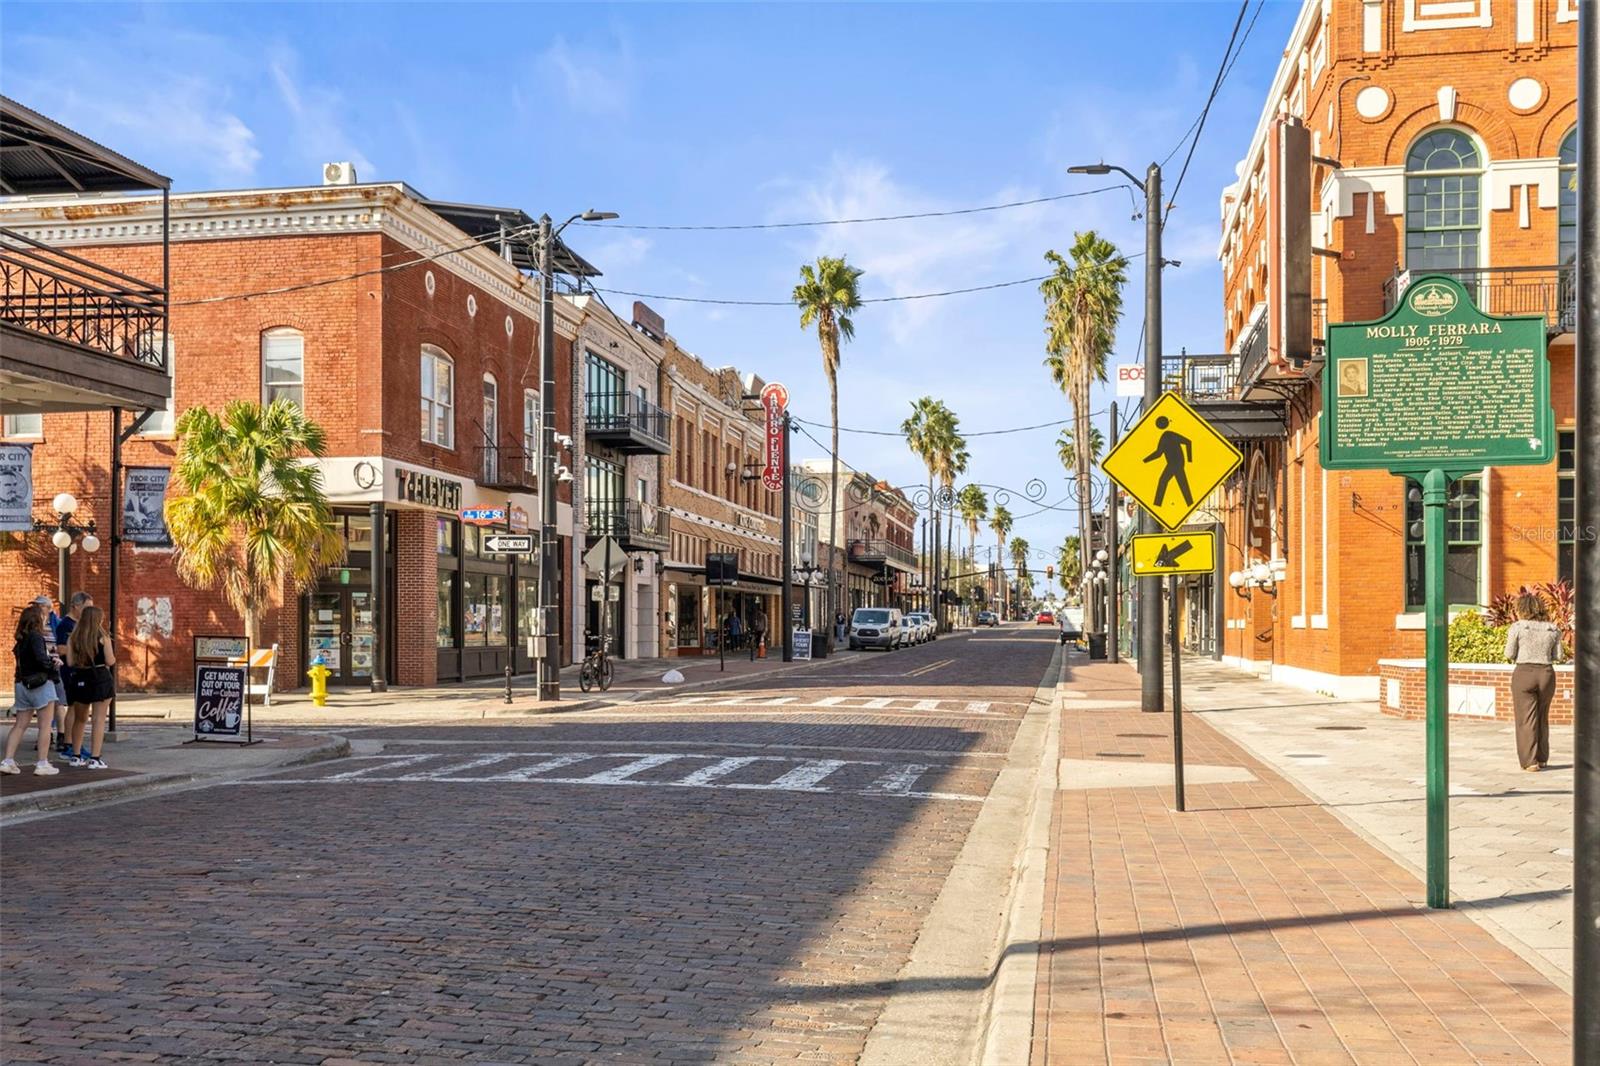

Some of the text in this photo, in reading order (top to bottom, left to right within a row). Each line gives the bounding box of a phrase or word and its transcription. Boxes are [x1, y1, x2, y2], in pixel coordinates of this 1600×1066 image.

[1366, 322, 1502, 338] MOLLY FERRARA
[8, 453, 26, 461] CITY
[498, 540, 510, 548] ONE
[204, 672, 239, 681] GET MORE
[220, 689, 240, 698] Cuban
[199, 697, 240, 722] Coffee
